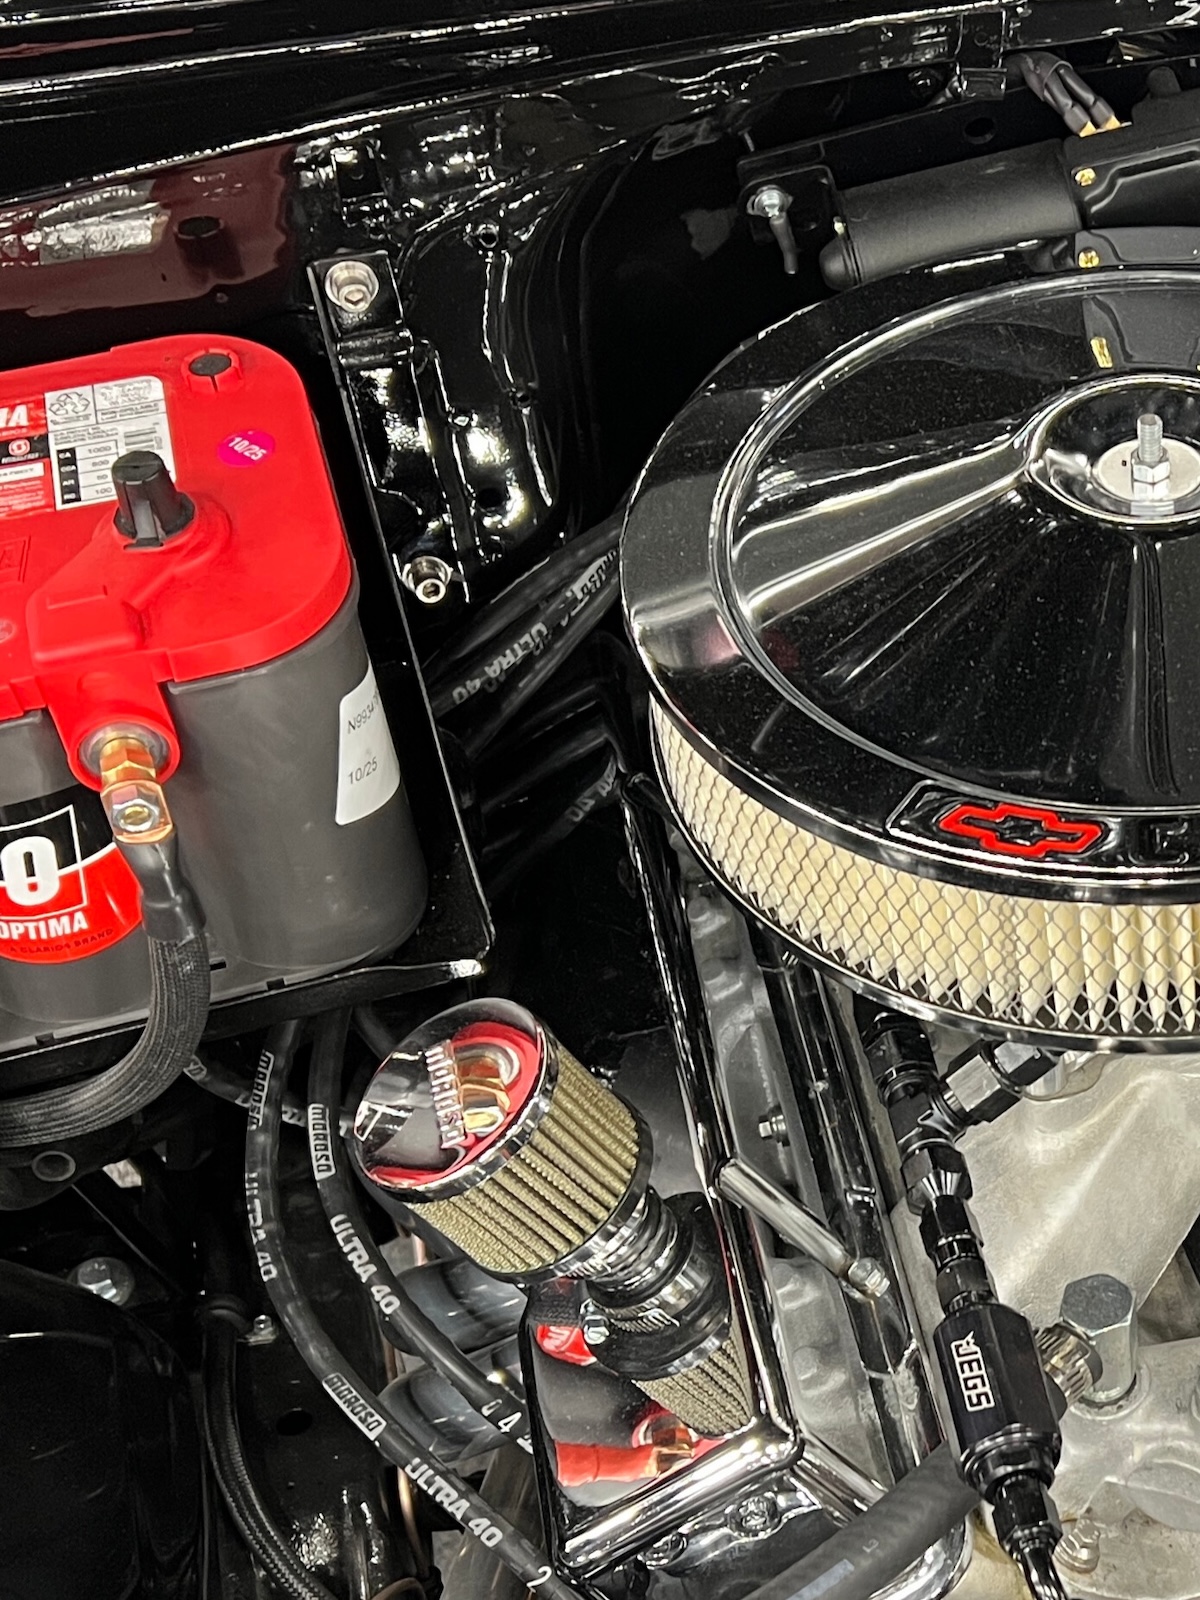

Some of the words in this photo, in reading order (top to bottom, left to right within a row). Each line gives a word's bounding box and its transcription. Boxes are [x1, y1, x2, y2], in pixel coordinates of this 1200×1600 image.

[88, 445, 112, 456] 1000
[228, 436, 267, 461] 10/25
[484, 622, 548, 678] ULTRA
[452, 677, 482, 703] 40
[348, 756, 378, 784] 10/25
[0, 911, 89, 940] OPTIMA
[74, 928, 114, 947] BRAND
[308, 1103, 336, 1180] MOROSO
[330, 1213, 378, 1284] ULTRA
[370, 1283, 401, 1316] 40
[950, 1334, 996, 1413] JEGS
[322, 1372, 388, 1441] MOROSO
[404, 1457, 471, 1521] ULTRA
[468, 1516, 504, 1548] 40
